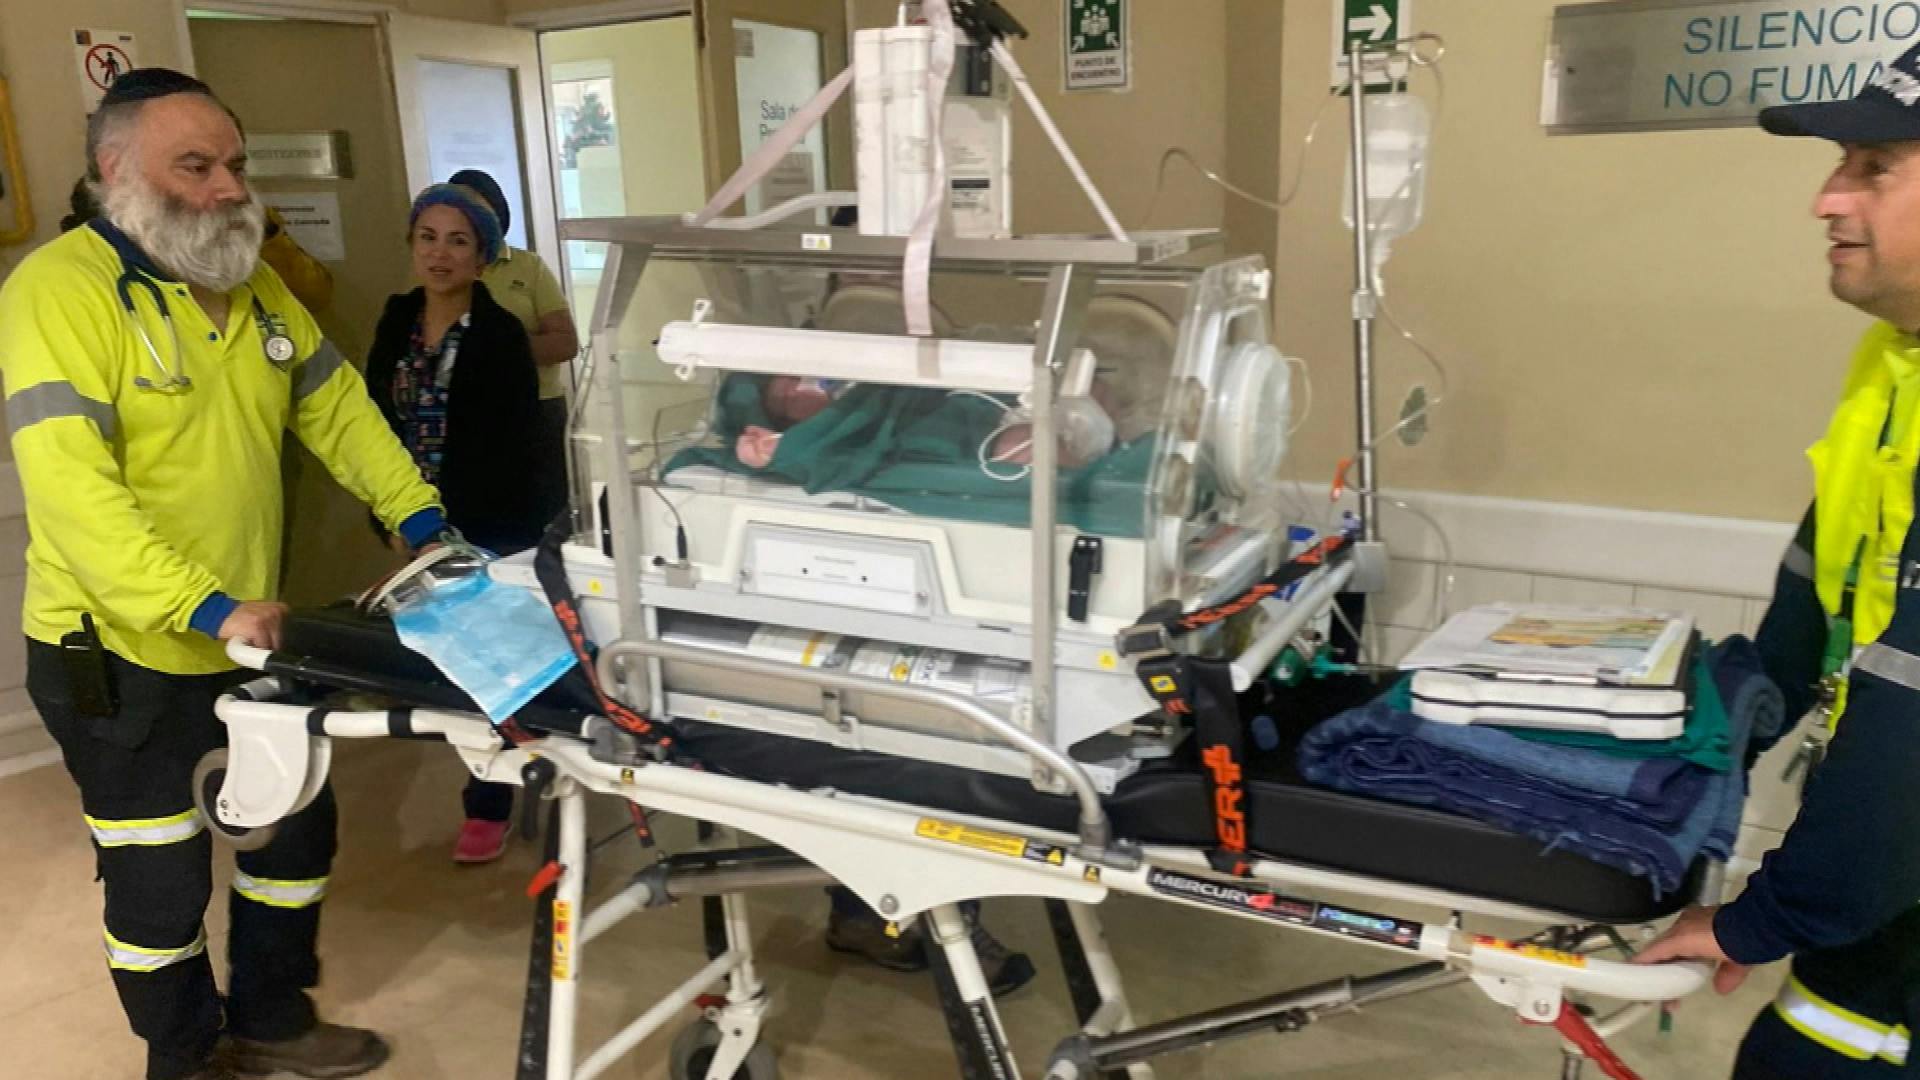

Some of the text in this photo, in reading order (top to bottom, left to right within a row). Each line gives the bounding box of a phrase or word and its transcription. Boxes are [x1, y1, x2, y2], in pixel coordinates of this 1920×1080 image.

[1683, 1, 1920, 54] SILENCIO
[1664, 70, 1732, 109] NO
[1750, 61, 1884, 104] FUMA
[761, 99, 785, 121] Sala
